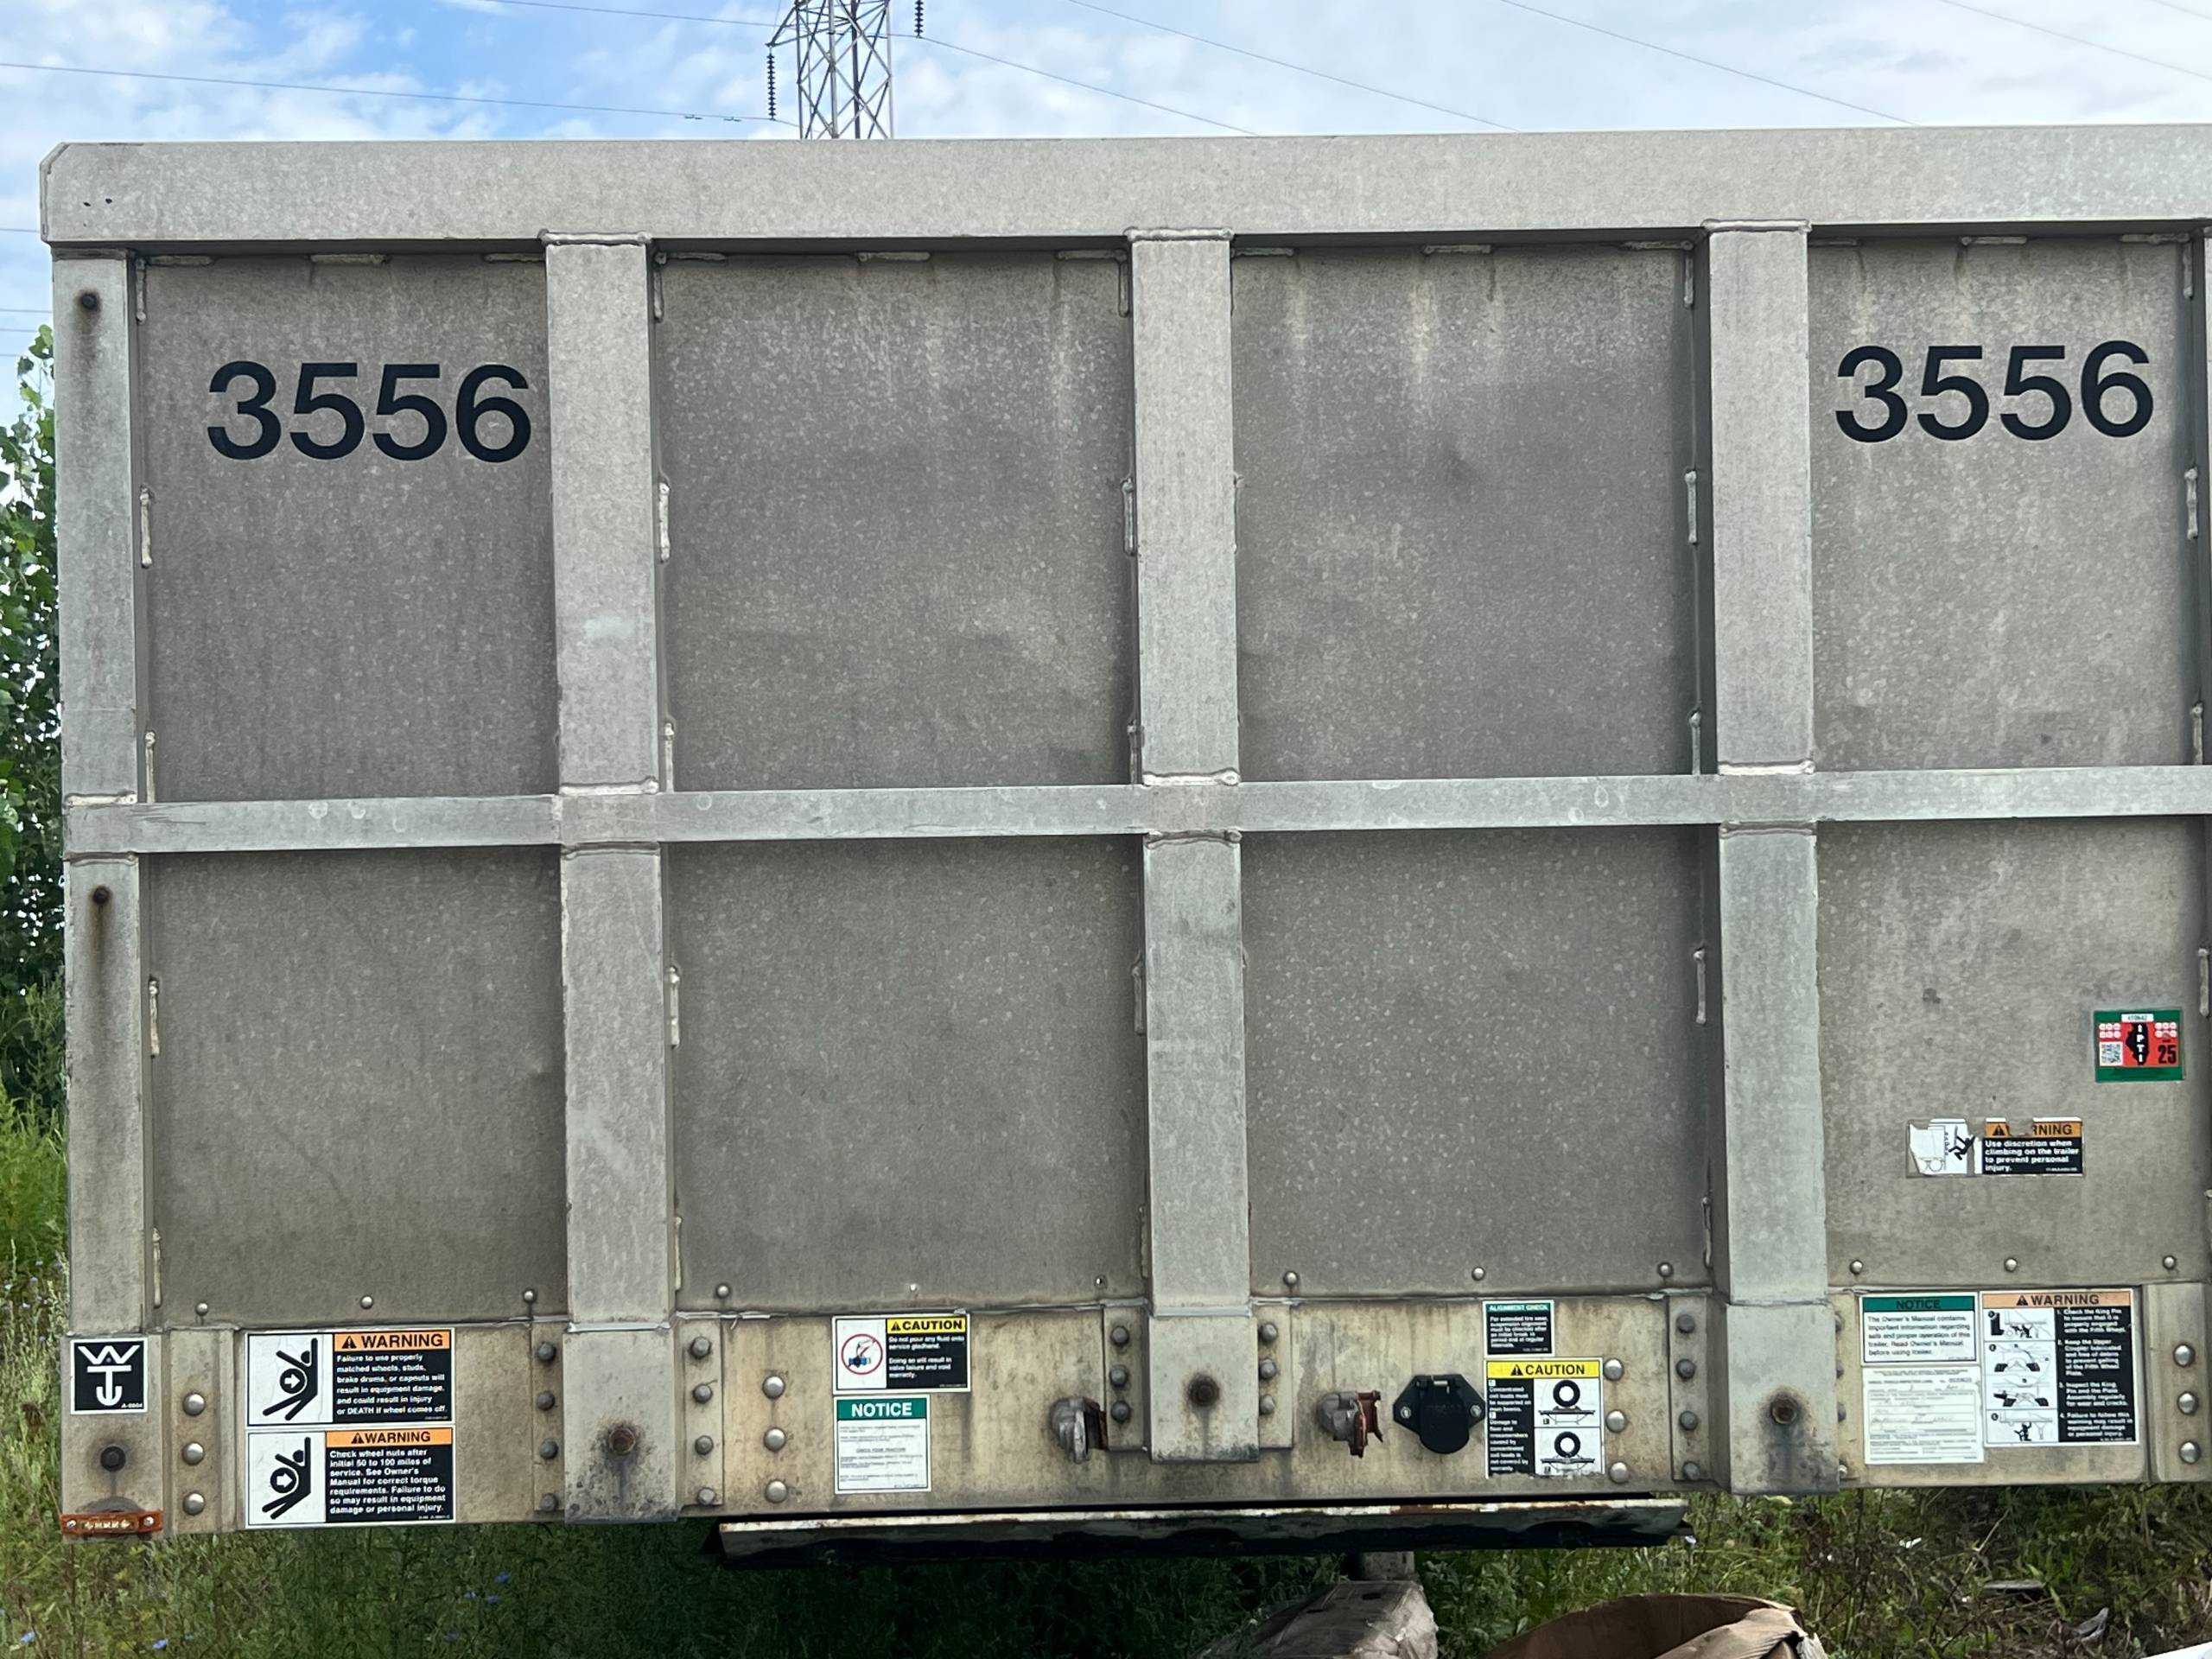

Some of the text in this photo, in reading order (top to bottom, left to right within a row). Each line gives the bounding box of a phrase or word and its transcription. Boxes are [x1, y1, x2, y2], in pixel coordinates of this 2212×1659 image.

[1835, 340, 2154, 442] 3556
[207, 360, 531, 463] 3556
[2158, 1045, 2177, 1064] 25
[1896, 1300, 1940, 1309] NOTICE
[2031, 1294, 2100, 1306] WARNING
[902, 1320, 962, 1330] CAUTION
[361, 1334, 442, 1348] WARNING
[1525, 1364, 1585, 1375] CAUTION
[852, 1402, 912, 1416] NOTICE
[365, 1432, 430, 1443] WARNING
[401, 1495, 445, 1503] equipment
[378, 1505, 414, 1514] personal
